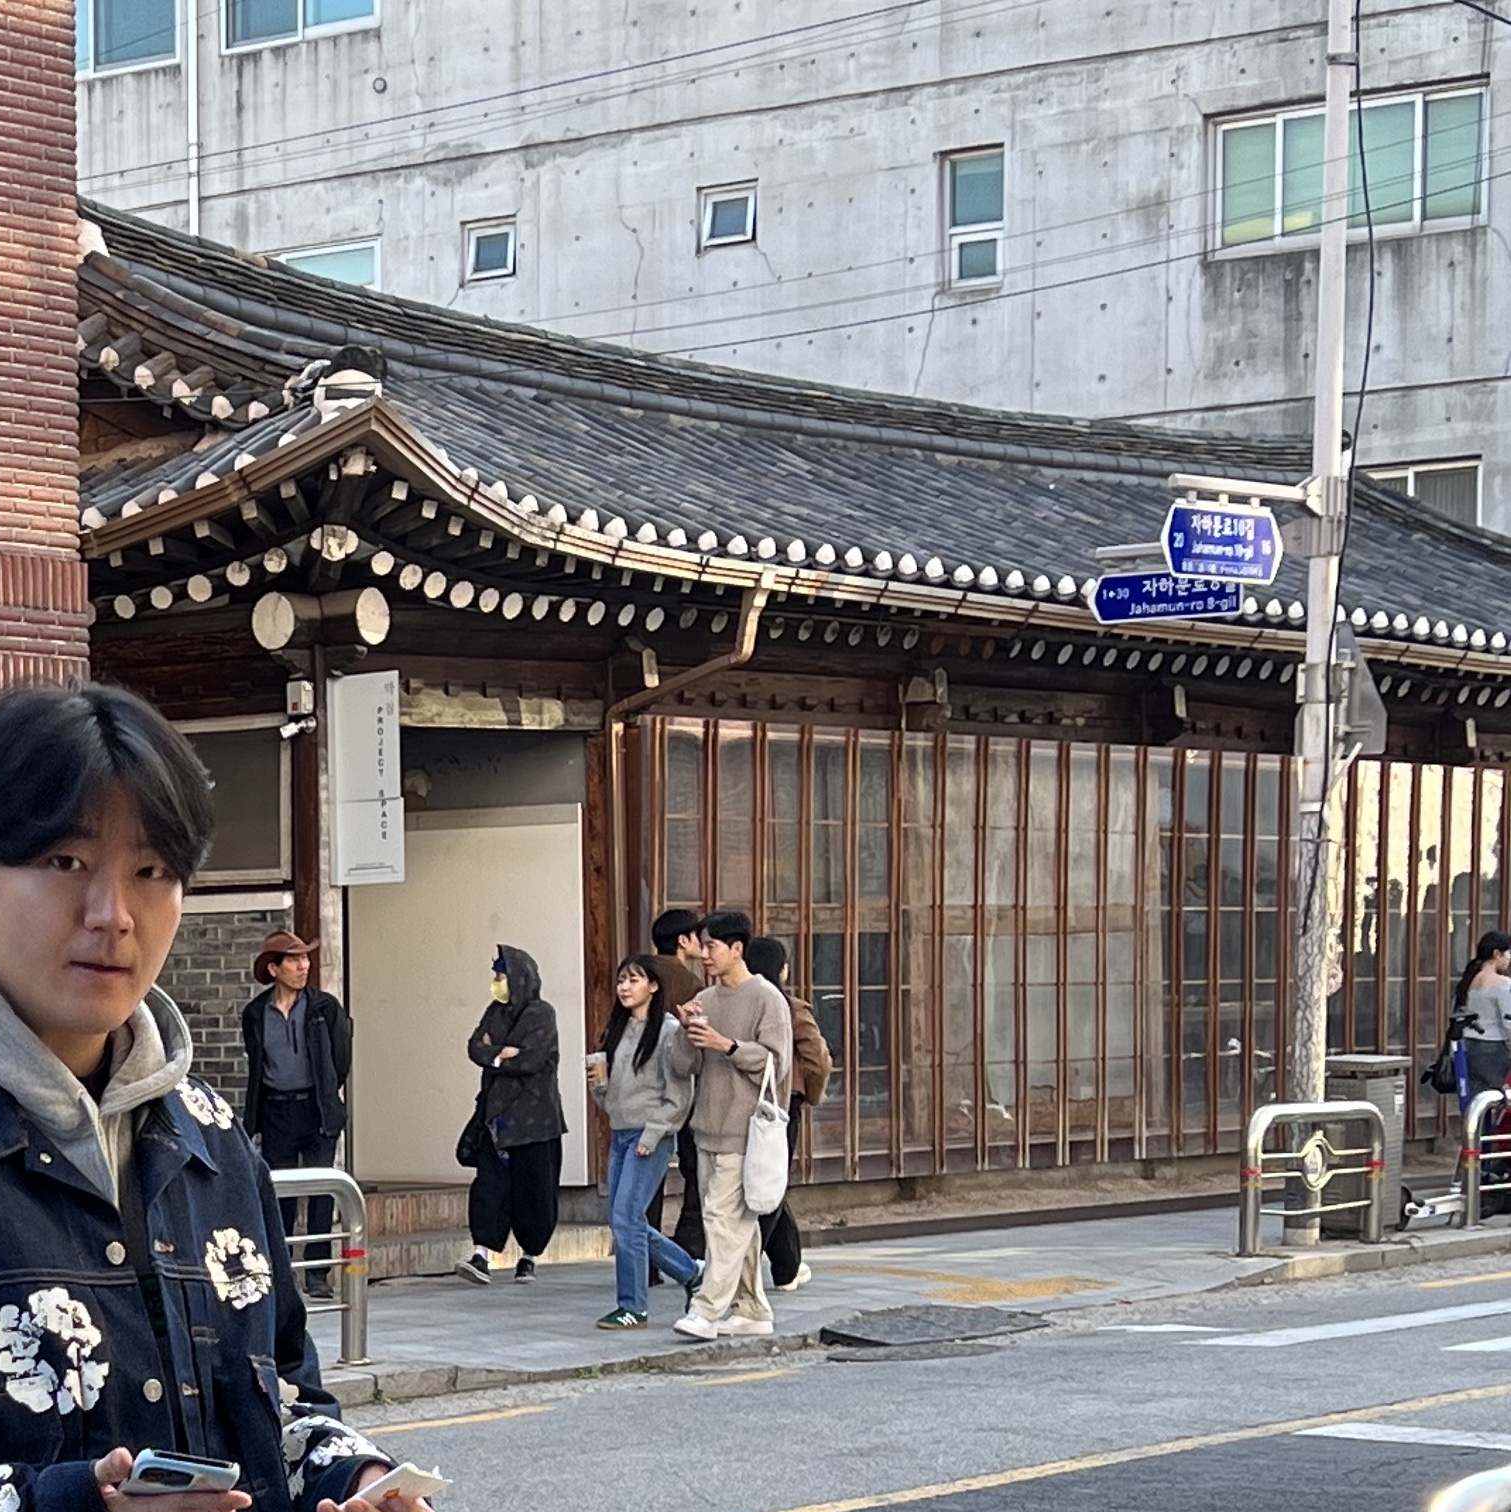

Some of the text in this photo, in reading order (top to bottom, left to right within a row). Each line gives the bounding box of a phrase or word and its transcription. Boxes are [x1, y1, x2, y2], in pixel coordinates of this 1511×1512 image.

[1129, 599, 1204, 615] Jahamun-ro
[377, 706, 387, 840] PROJECT SPACE
